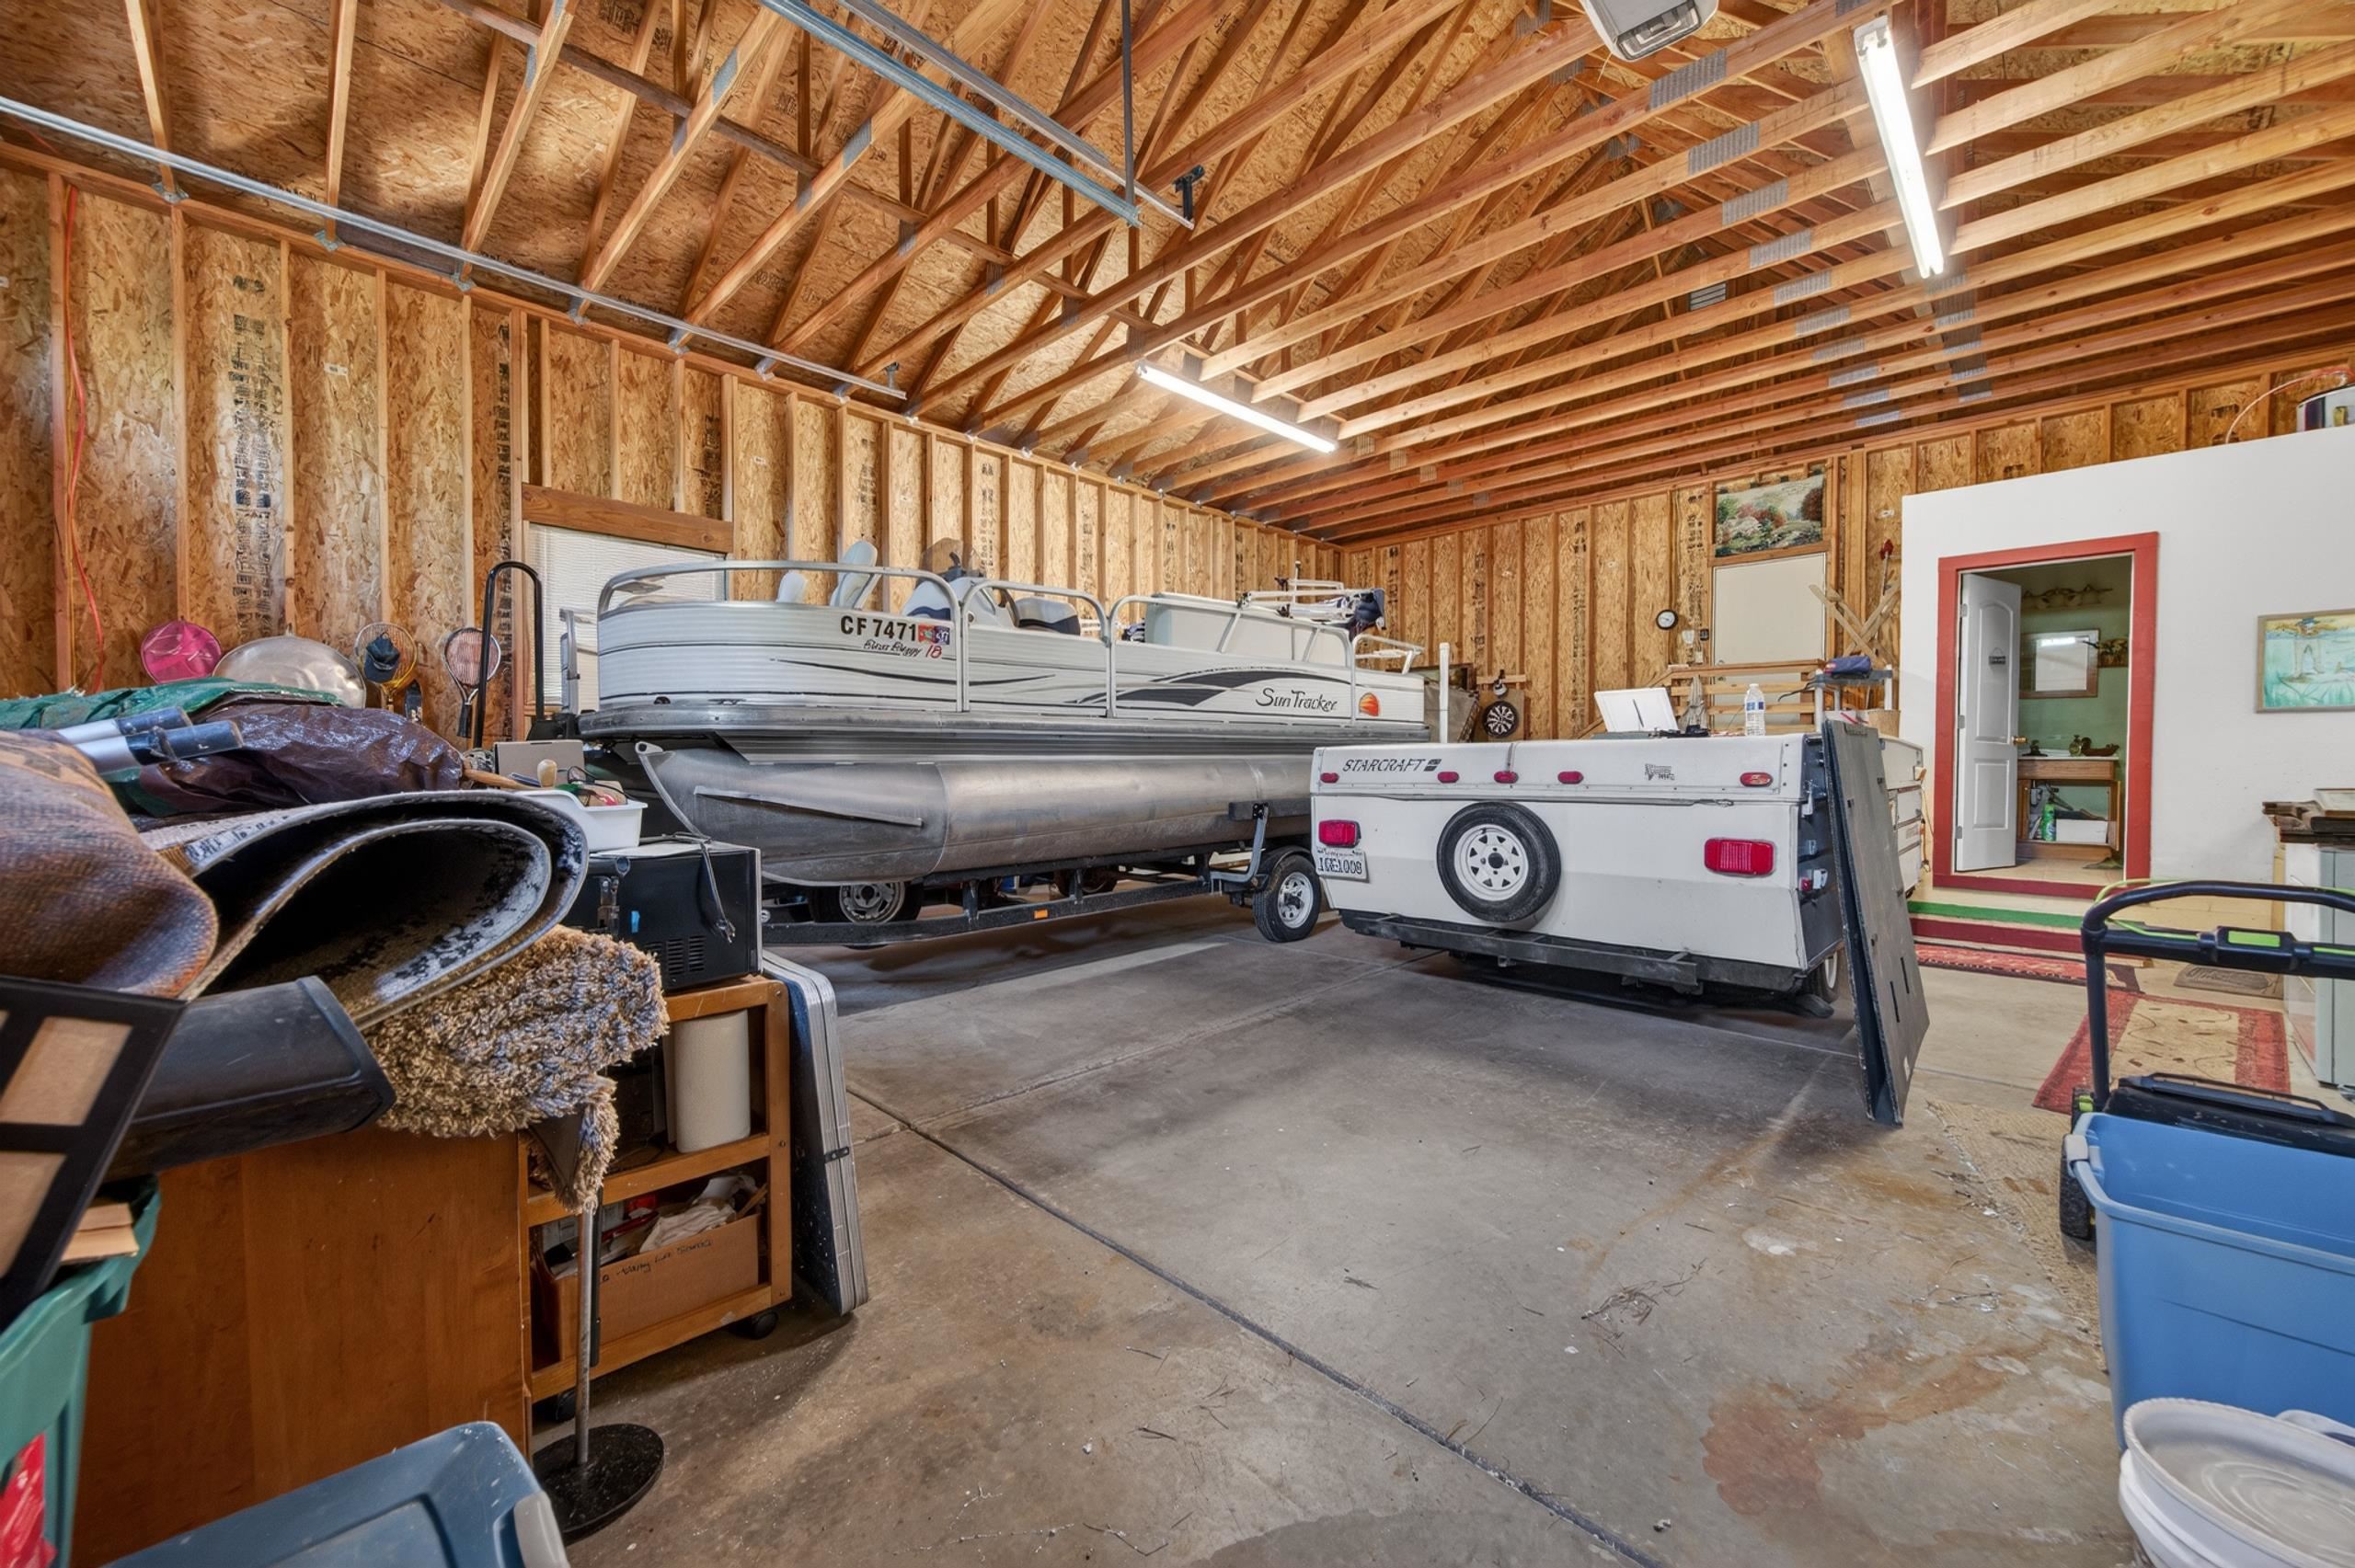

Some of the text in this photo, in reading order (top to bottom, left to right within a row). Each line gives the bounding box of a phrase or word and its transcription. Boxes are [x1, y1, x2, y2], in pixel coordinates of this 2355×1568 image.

[840, 614, 867, 635] CF
[872, 618, 916, 642] 7471
[1342, 758, 1427, 773] STARCRAFT
